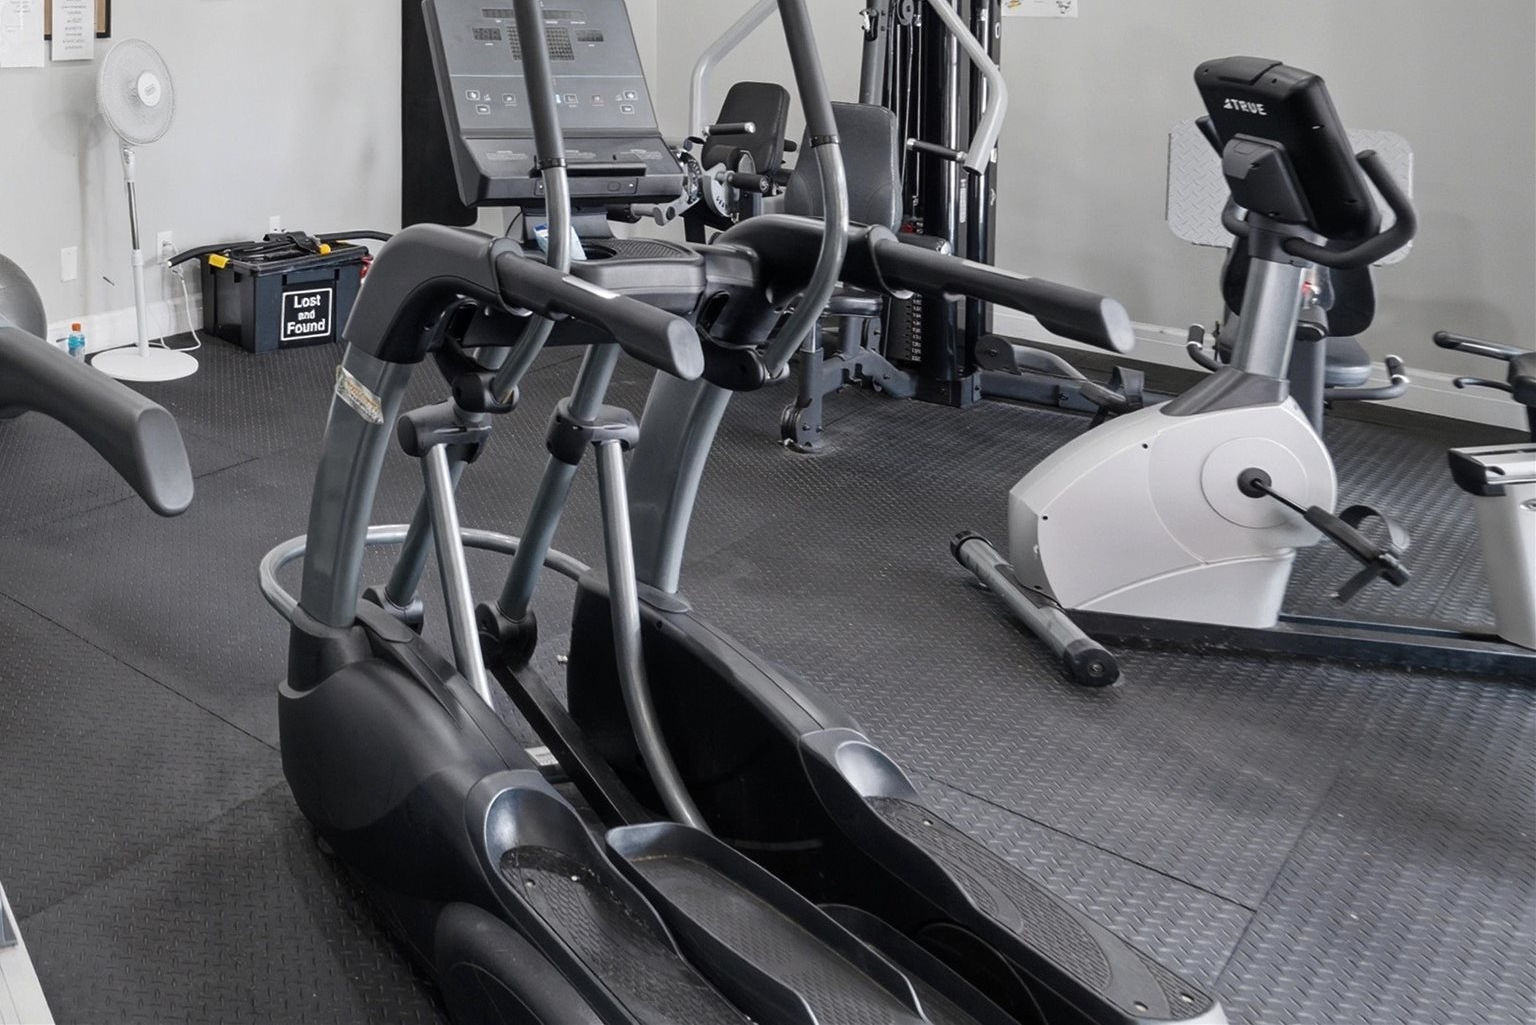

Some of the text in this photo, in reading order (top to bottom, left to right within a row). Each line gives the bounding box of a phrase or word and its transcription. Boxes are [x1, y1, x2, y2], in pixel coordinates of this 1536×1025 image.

[1232, 99, 1268, 116] TRUE
[293, 294, 321, 308] Lost
[298, 309, 316, 320] and
[287, 319, 326, 335] Found
